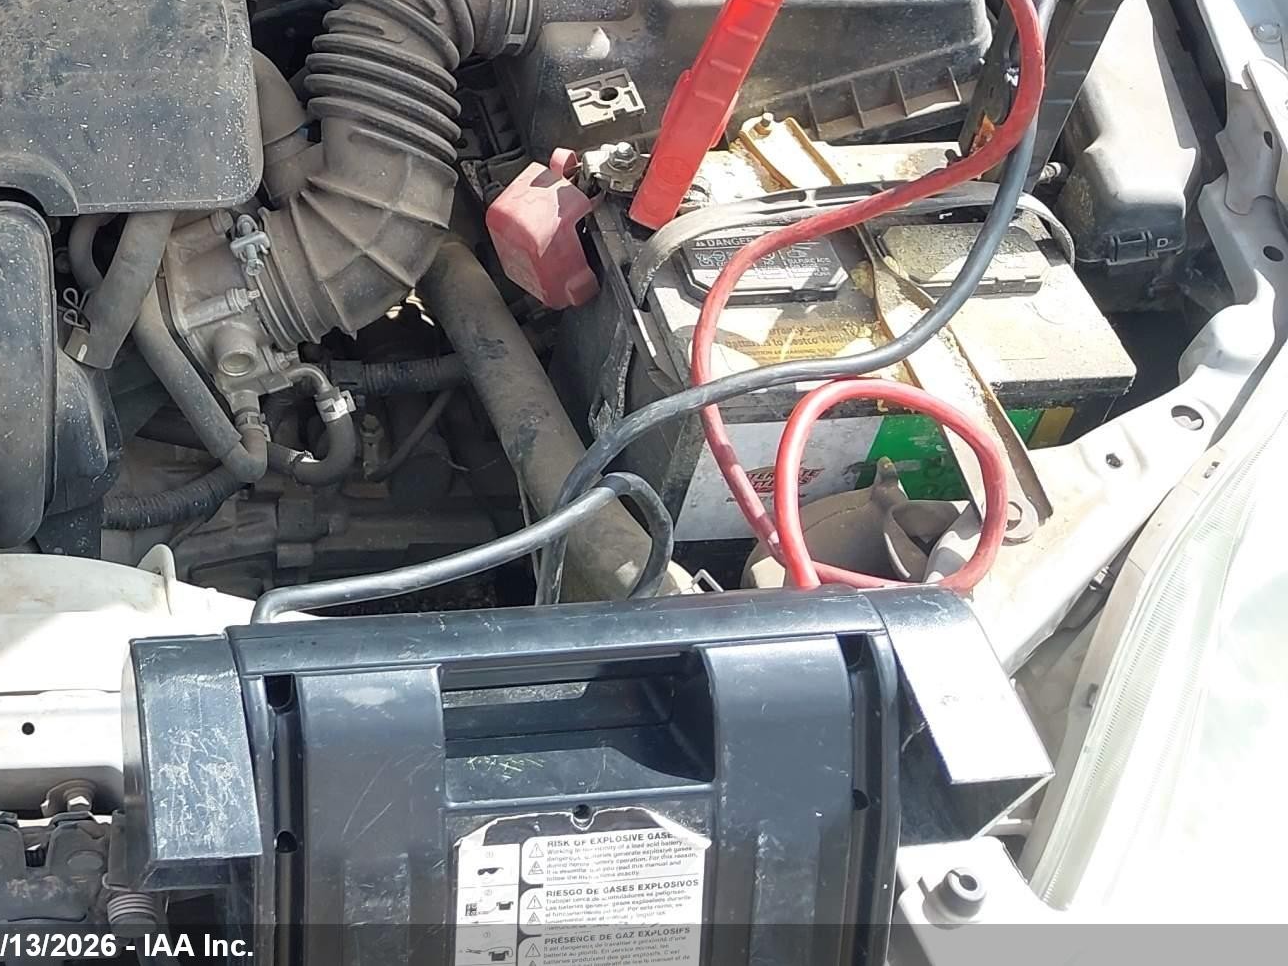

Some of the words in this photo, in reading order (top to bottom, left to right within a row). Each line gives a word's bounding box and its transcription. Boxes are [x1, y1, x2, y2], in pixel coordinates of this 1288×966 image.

[590, 834, 644, 845] EXPLOSIVE
[546, 888, 583, 897] RIESGO
[603, 884, 635, 894] GASES
[638, 879, 699, 891] EXPLOSIVOS
[599, 933, 612, 941] DE
[616, 931, 634, 939] GAZ
[638, 927, 691, 937] EXPLOSIFS
